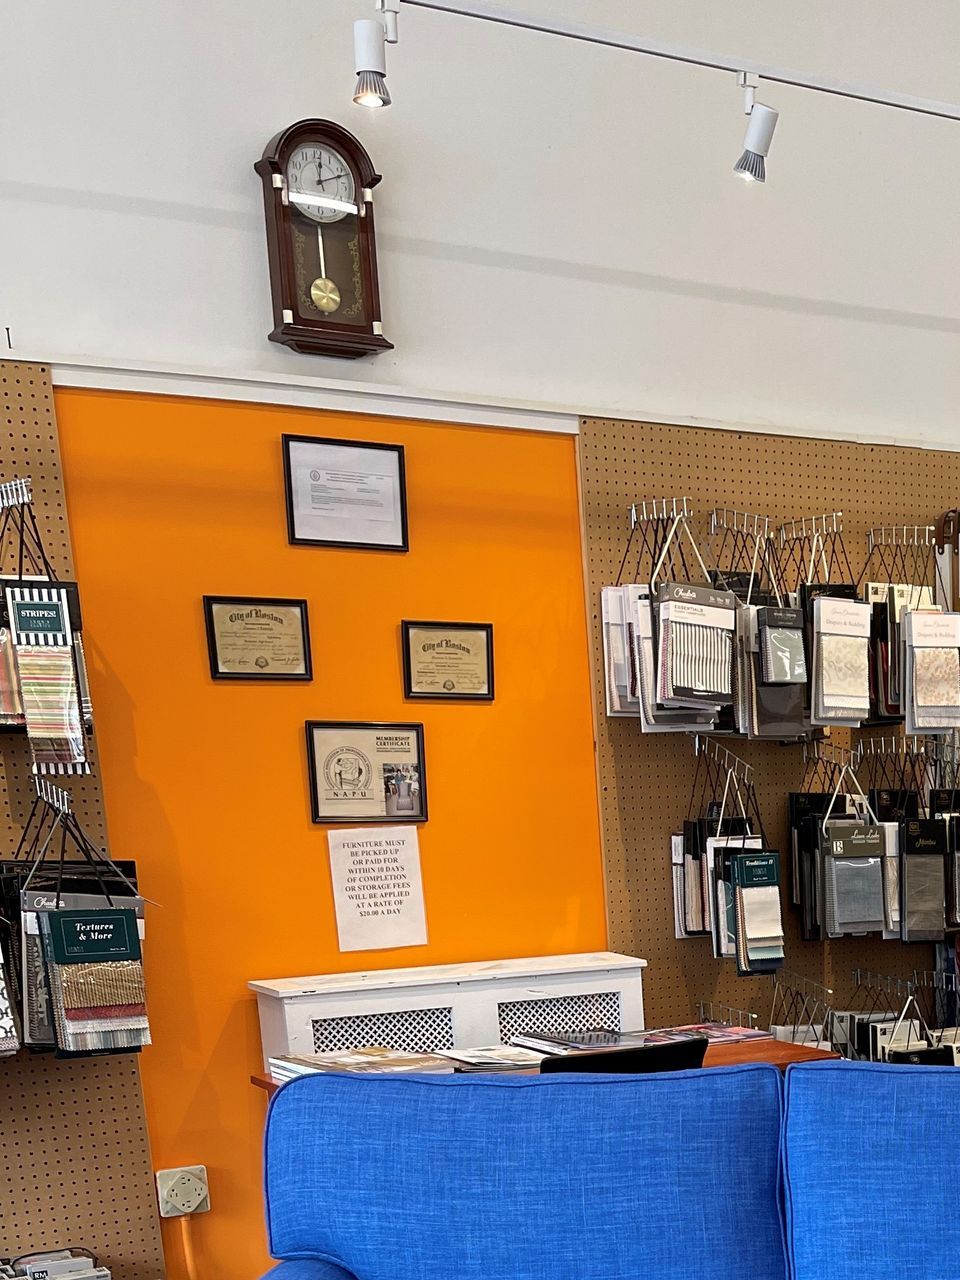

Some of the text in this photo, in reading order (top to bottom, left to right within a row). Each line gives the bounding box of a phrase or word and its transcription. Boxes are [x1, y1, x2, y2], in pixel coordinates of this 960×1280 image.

[301, 151, 308, 161] 11
[313, 150, 322, 160] 12
[292, 160, 301, 170] 10
[291, 173, 298, 183] 9
[317, 206, 324, 215] 6
[20, 609, 57, 618] STRIPES!
[228, 612, 245, 623] City
[254, 608, 284, 625] Boston
[421, 643, 436, 653] City
[445, 639, 471, 655] Boston
[342, 839, 406, 849] FURNITURE MUST
[361, 849, 388, 857] PICKED
[348, 866, 376, 874] WITHIN
[358, 873, 407, 883] COMPLETION
[357, 883, 392, 891] STORAGE
[379, 890, 410, 899] APPLIED
[373, 900, 393, 908] RATE
[74, 922, 114, 932] Textures
[79, 932, 113, 941] & More
